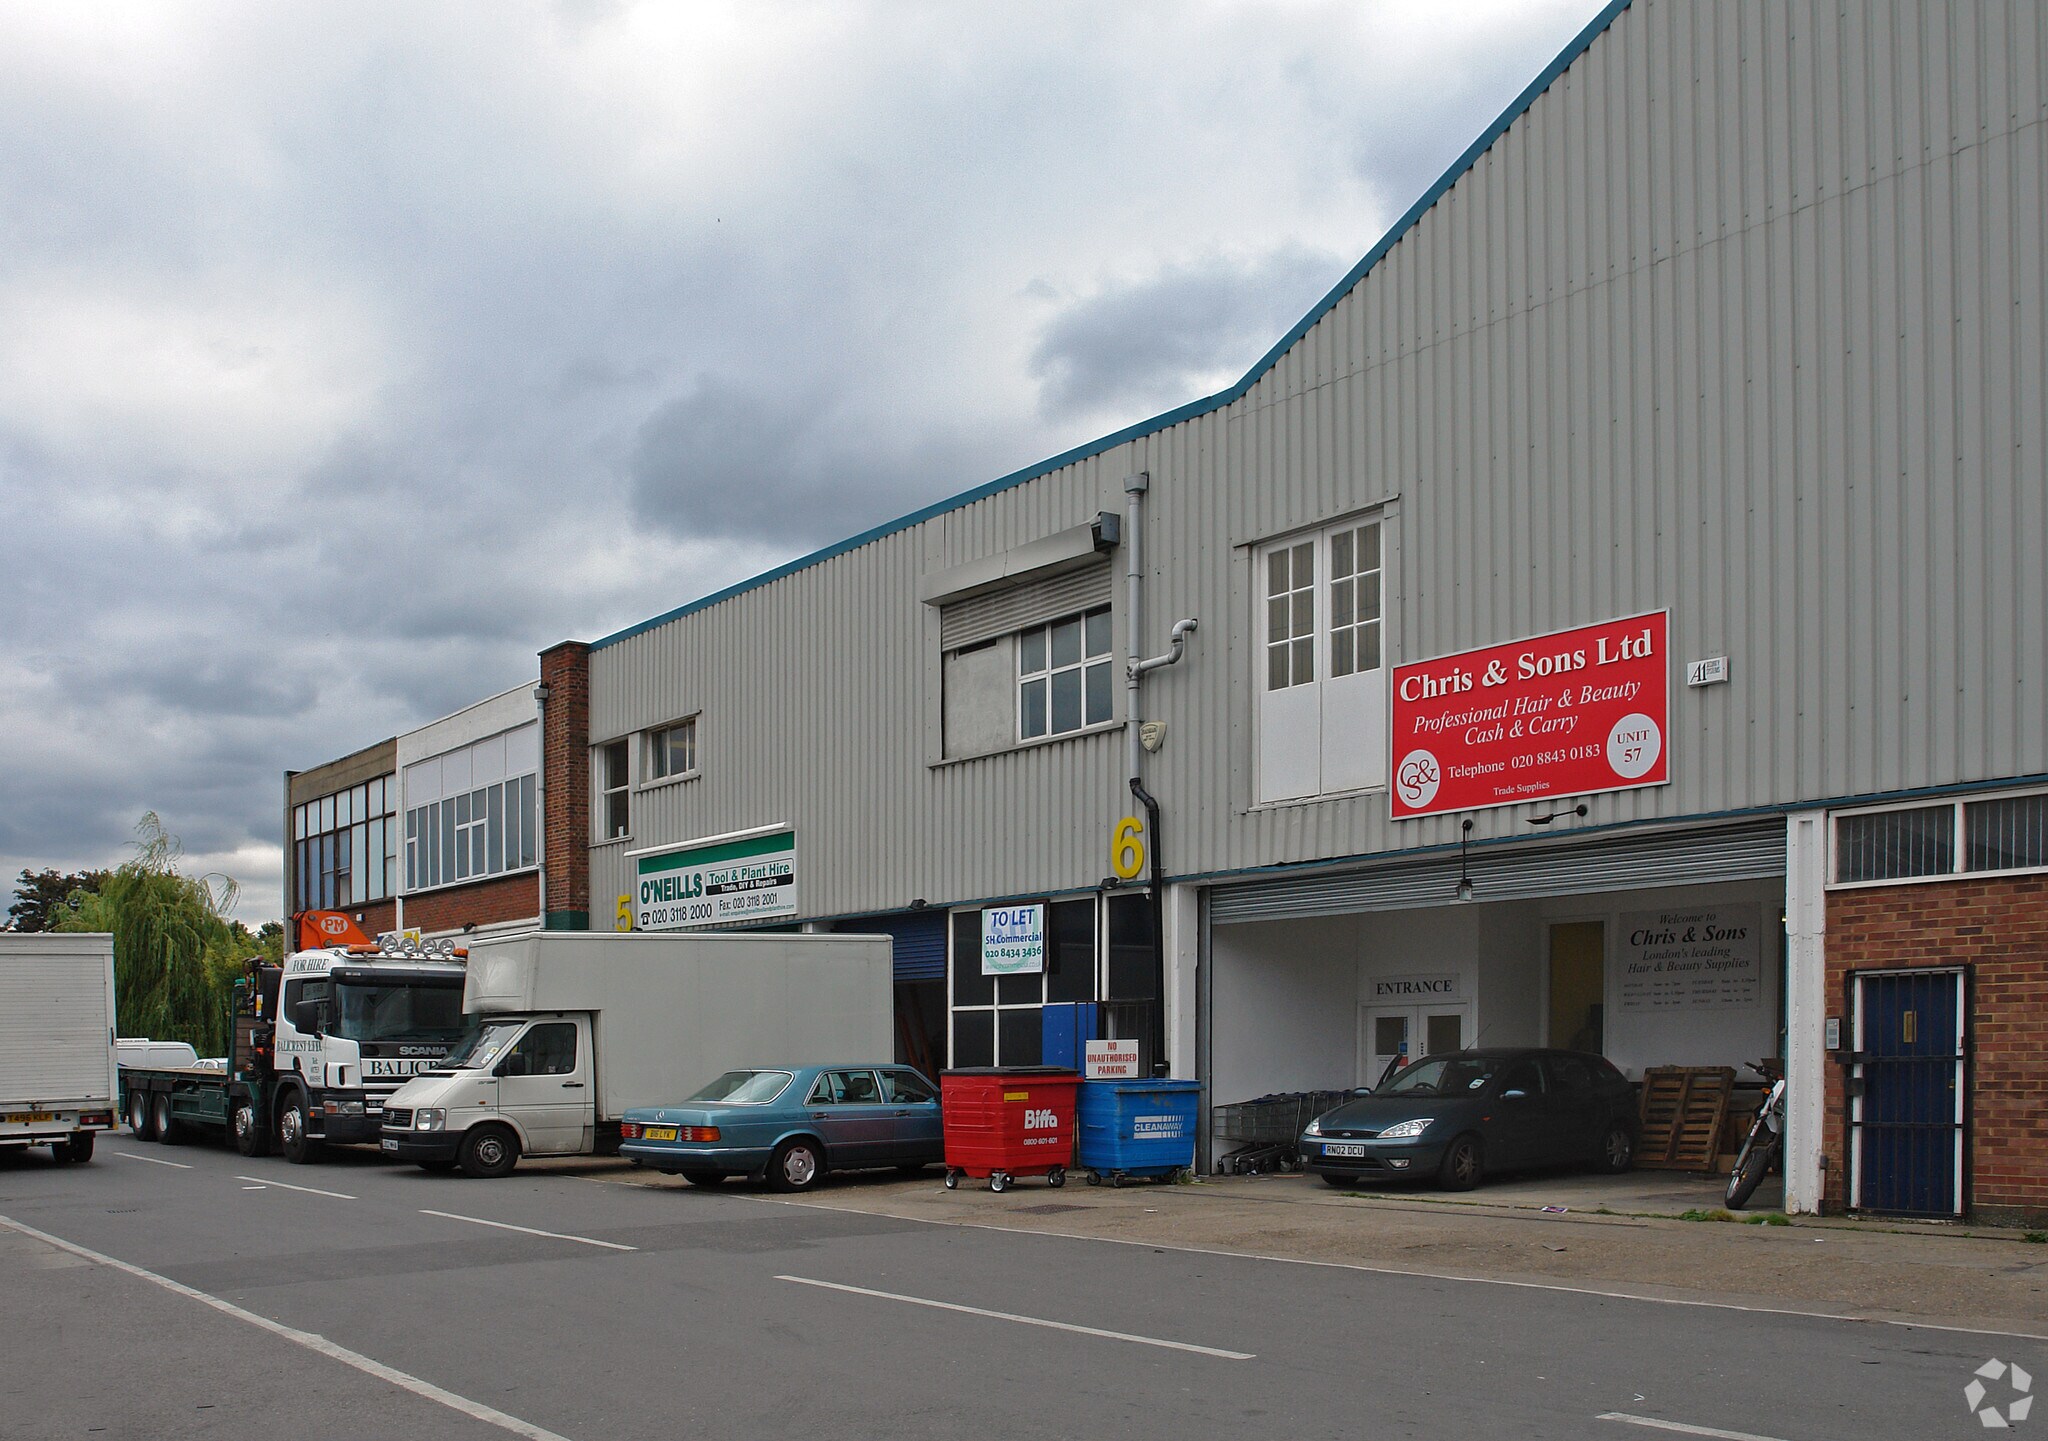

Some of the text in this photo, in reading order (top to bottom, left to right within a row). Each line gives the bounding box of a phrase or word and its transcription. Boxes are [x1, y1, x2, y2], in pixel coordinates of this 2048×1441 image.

[1400, 629, 1653, 702] Chris & Sons Ltd
[1413, 680, 1640, 734] Professional Hair & Beauty
[1465, 716, 1578, 745] Cash & Carry
[1617, 730, 1650, 744] UNIT
[1448, 744, 1600, 778] Telephone 020 8843 0183
[1624, 747, 1641, 762] 57
[1493, 781, 1550, 796] Trade Supplies
[1112, 816, 1144, 878] 6
[709, 863, 790, 884] Tool & Plant Hire
[641, 873, 702, 904] O'NEILLS
[756, 878, 777, 888] Repairs
[720, 899, 731, 911] Fax:
[733, 897, 745, 909] 020
[746, 895, 760, 907] 3118
[762, 893, 777, 905] 2001
[615, 895, 632, 931] 5
[652, 909, 667, 924] 020
[670, 906, 687, 922] 3118
[690, 903, 712, 919] 2000
[991, 909, 1035, 927] TO LET
[1659, 913, 1716, 924] Welcome to
[324, 918, 345, 932] PM
[985, 932, 1042, 944] SH Commercial
[1630, 925, 1747, 946] Chris & Sons
[1000, 948, 1020, 958] 8434
[1022, 946, 1042, 957] 3436
[1642, 946, 1730, 961] London's leading
[293, 959, 329, 972] FOR HIRE
[1627, 957, 1750, 974] Hair & Beauty Supplies
[1377, 979, 1453, 995] ENTRANCE
[399, 1046, 448, 1055] SCANIA
[1107, 1042, 1117, 1050] NO
[1087, 1053, 1137, 1063] UNAUTHORISED
[371, 1060, 439, 1075] BALICR
[1097, 1065, 1127, 1074] PARKING
[1024, 1109, 1058, 1129] Biffa
[1133, 1122, 1183, 1132] CLEANAWAY
[1326, 1145, 1363, 1155] RN02 DCU
